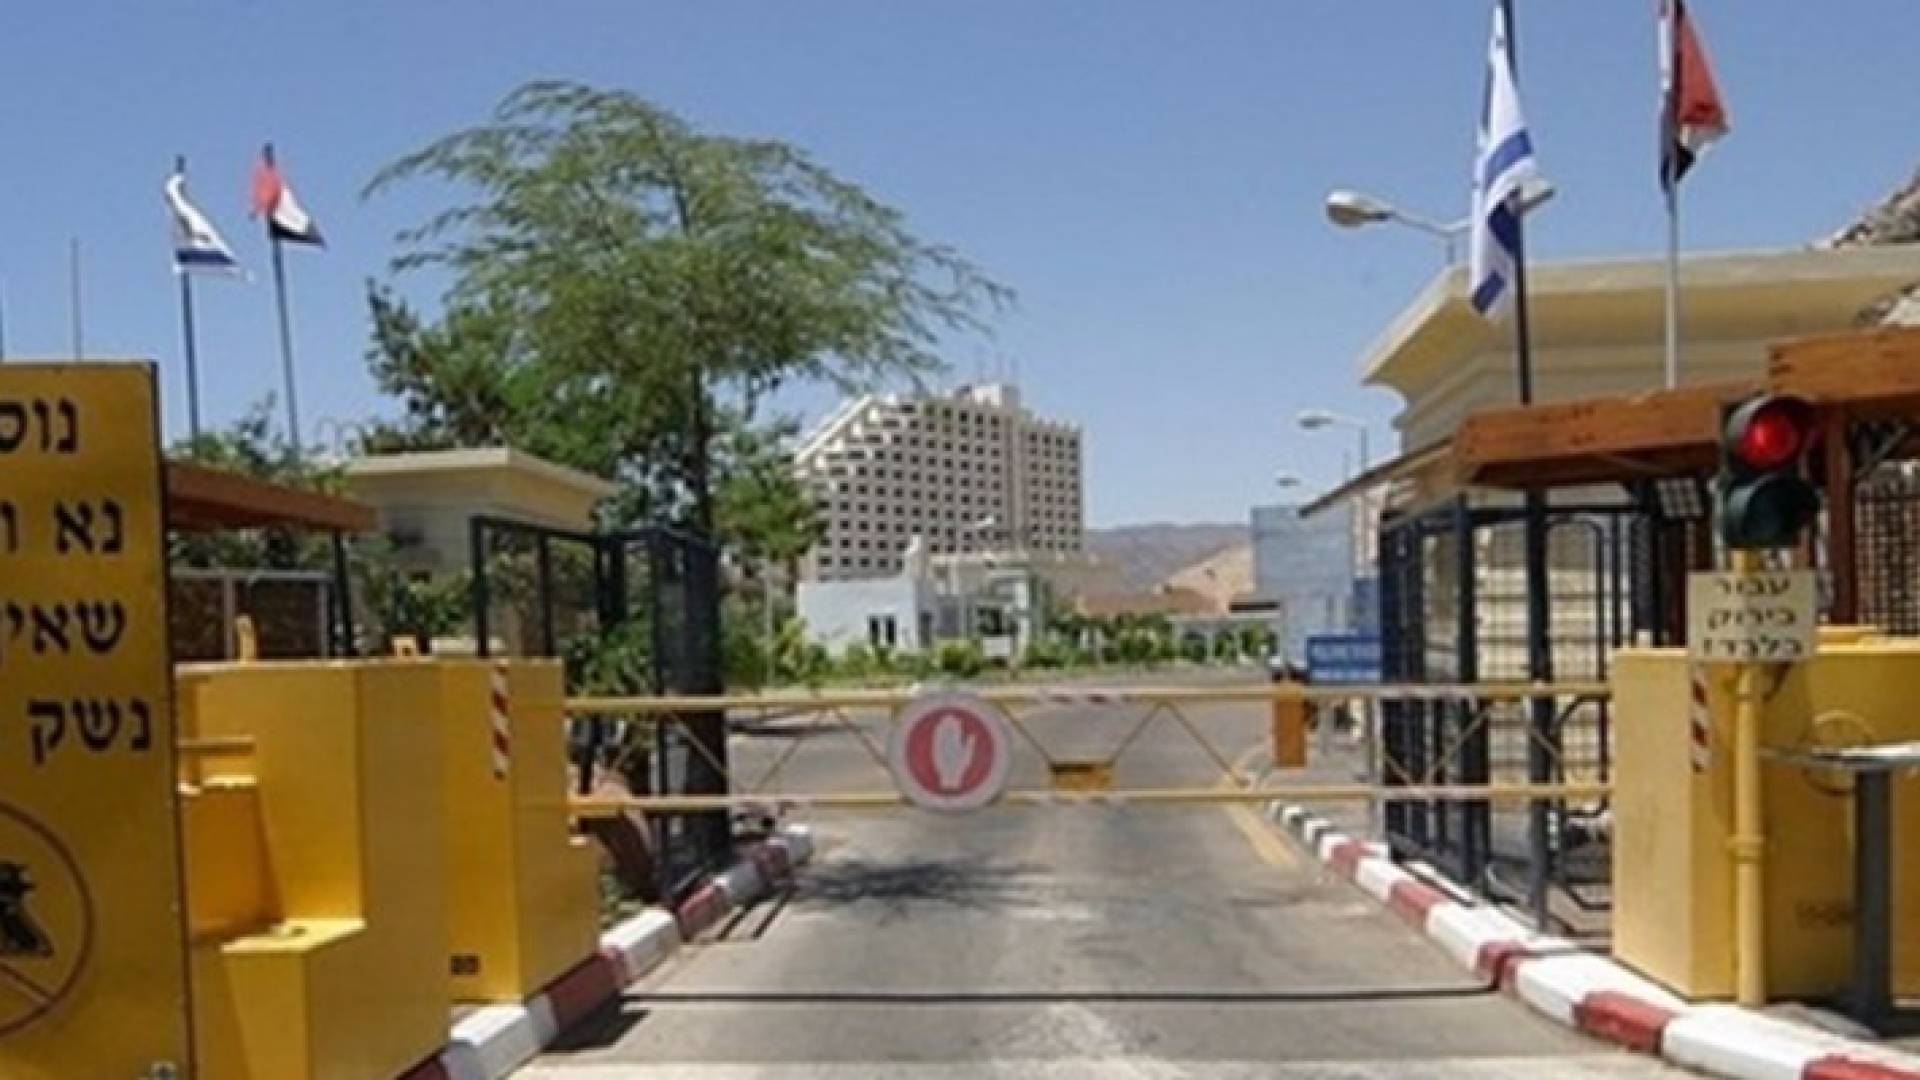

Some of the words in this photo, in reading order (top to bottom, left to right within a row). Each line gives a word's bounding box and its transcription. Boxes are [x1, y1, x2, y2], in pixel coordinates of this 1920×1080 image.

[54, 500, 122, 553] נא
[1713, 577, 1791, 595] עבור
[1707, 607, 1796, 630] בירוק
[26, 699, 150, 766] נשק
